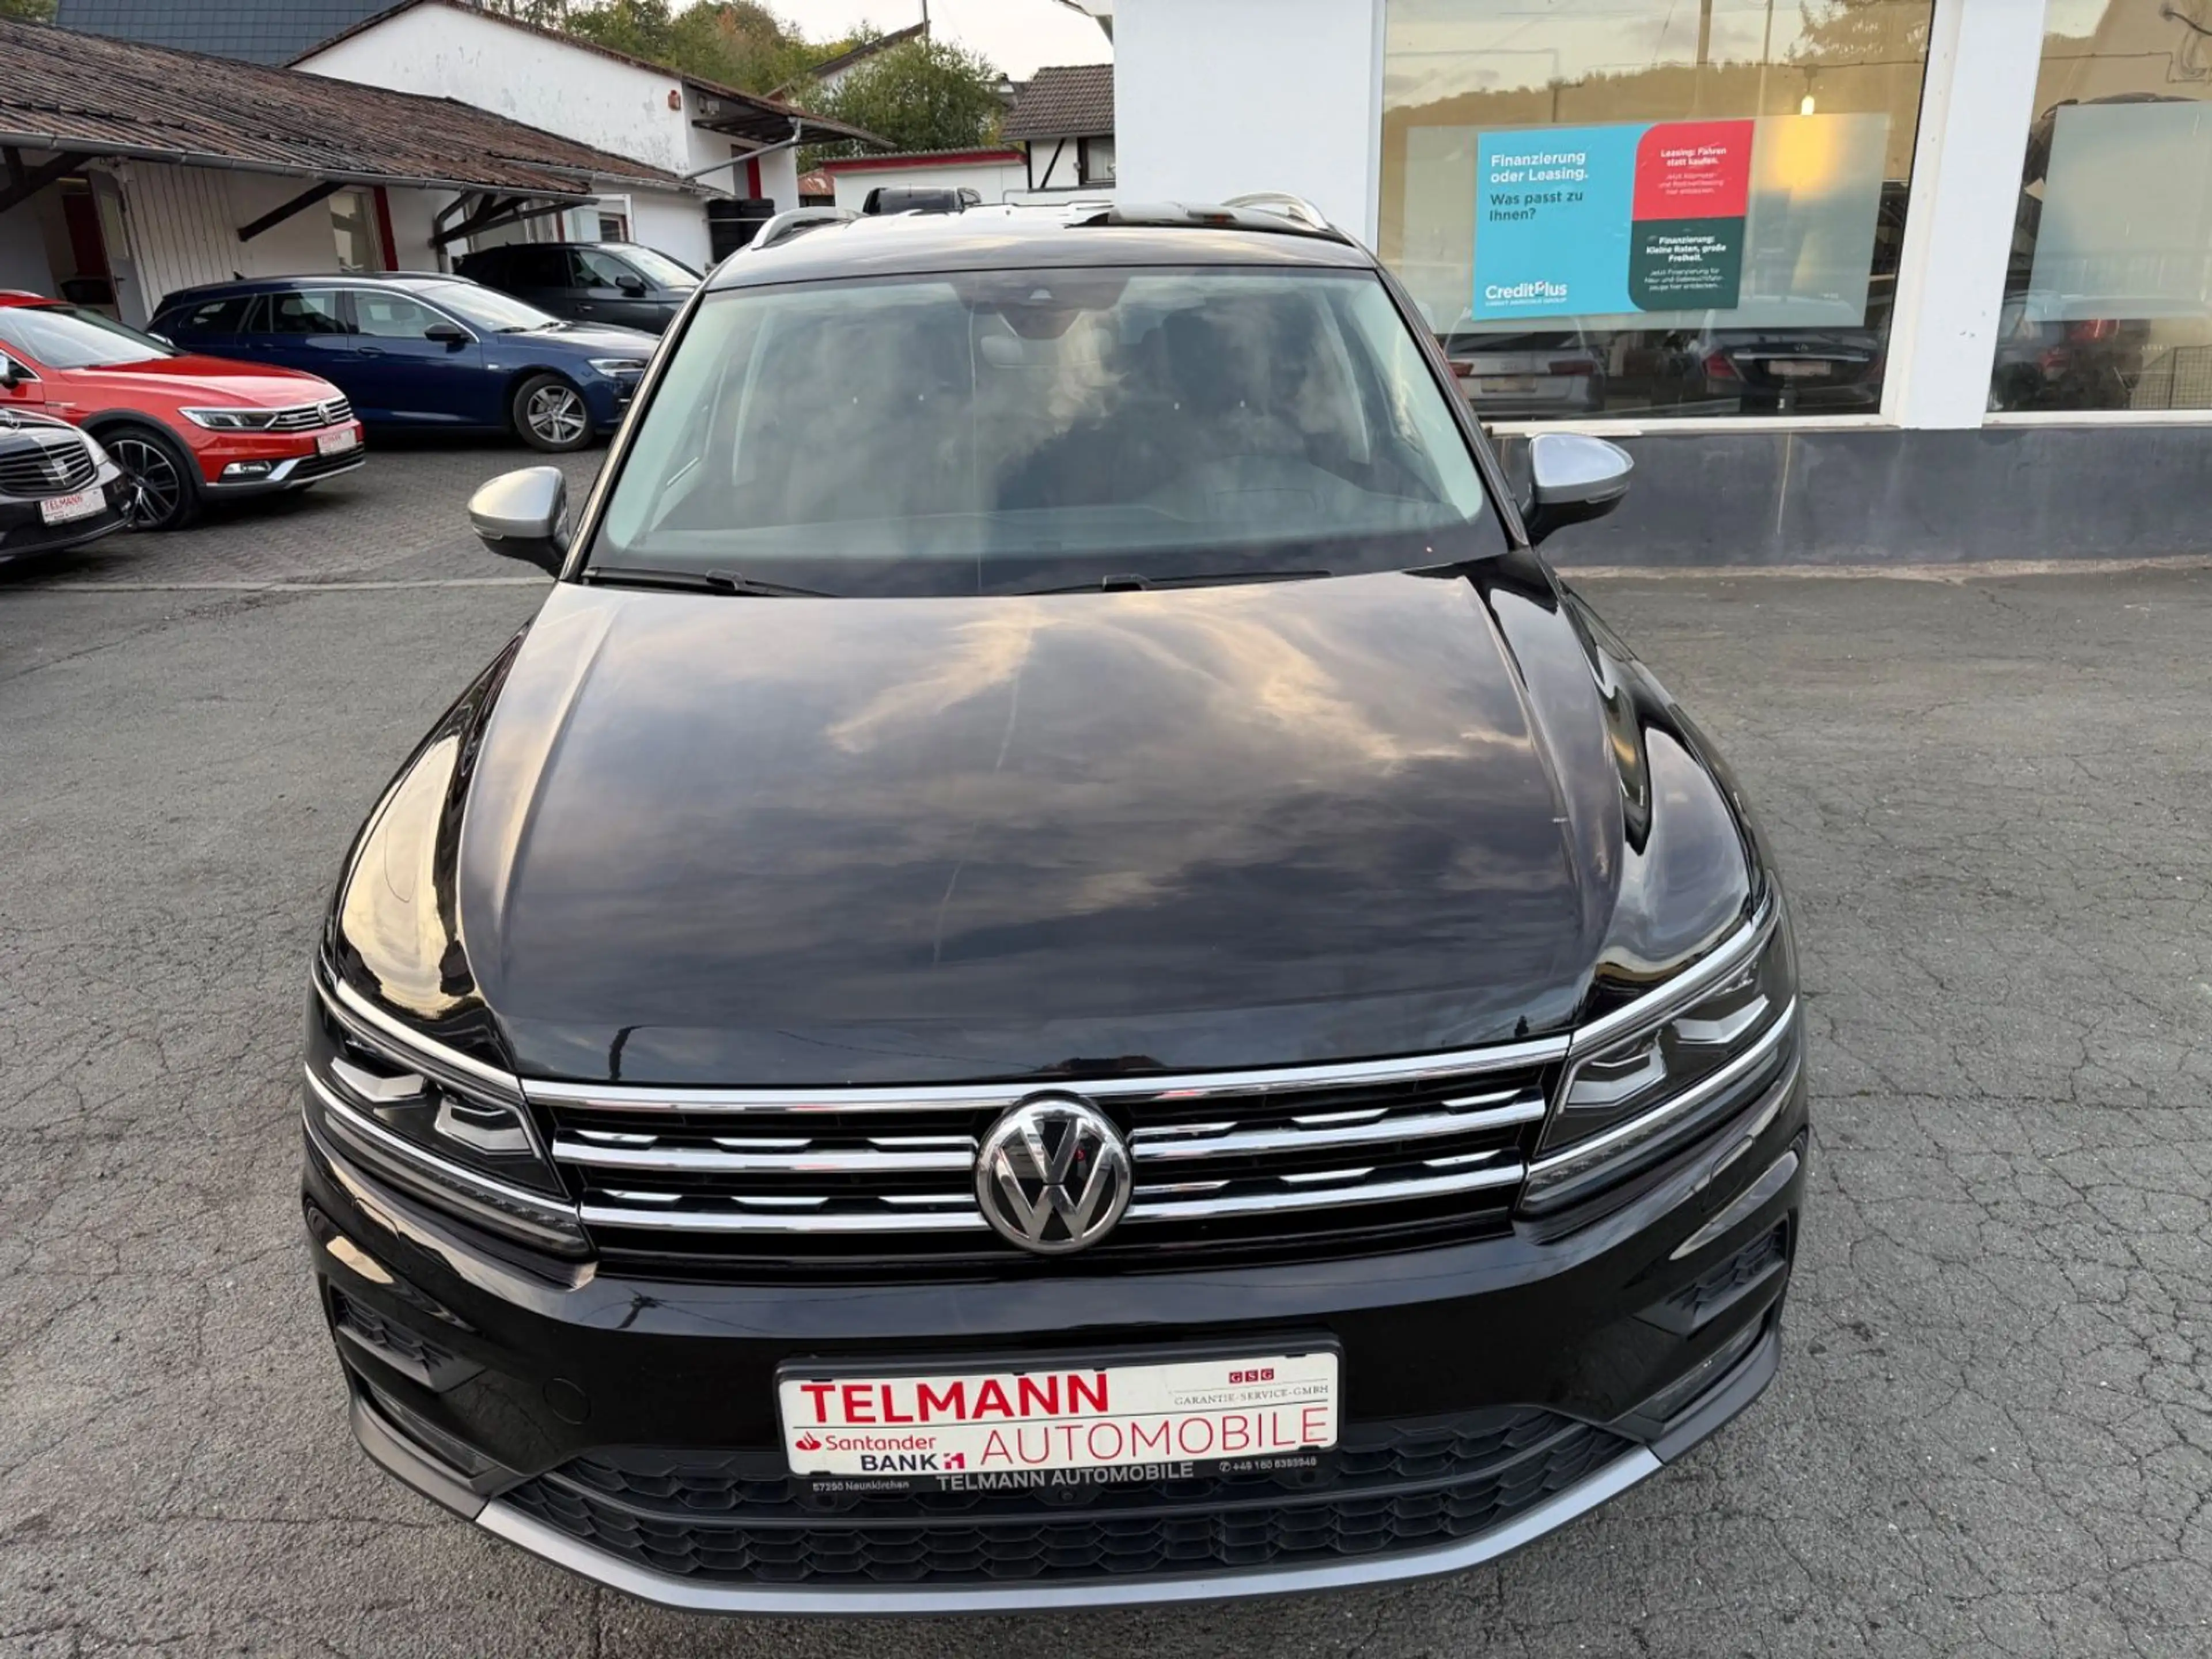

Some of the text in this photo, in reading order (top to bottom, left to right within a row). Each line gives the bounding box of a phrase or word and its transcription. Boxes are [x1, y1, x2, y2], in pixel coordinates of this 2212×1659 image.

[1491, 152, 1585, 166] Finanzierung
[1491, 166, 1589, 183] oder Leasing.
[1490, 191, 1583, 206] Was passt zu
[1490, 207, 1536, 222] Ihnen?
[1486, 281, 1568, 299] CreditPlus
[800, 1373, 1108, 1423] TELMANN
[825, 1434, 937, 1451] Santander
[980, 1407, 1328, 1466] AUTOMOBILE
[935, 1462, 1194, 1491] TELMANN AUTOMOBILE
[846, 1480, 910, 1491] Neunkirchen
